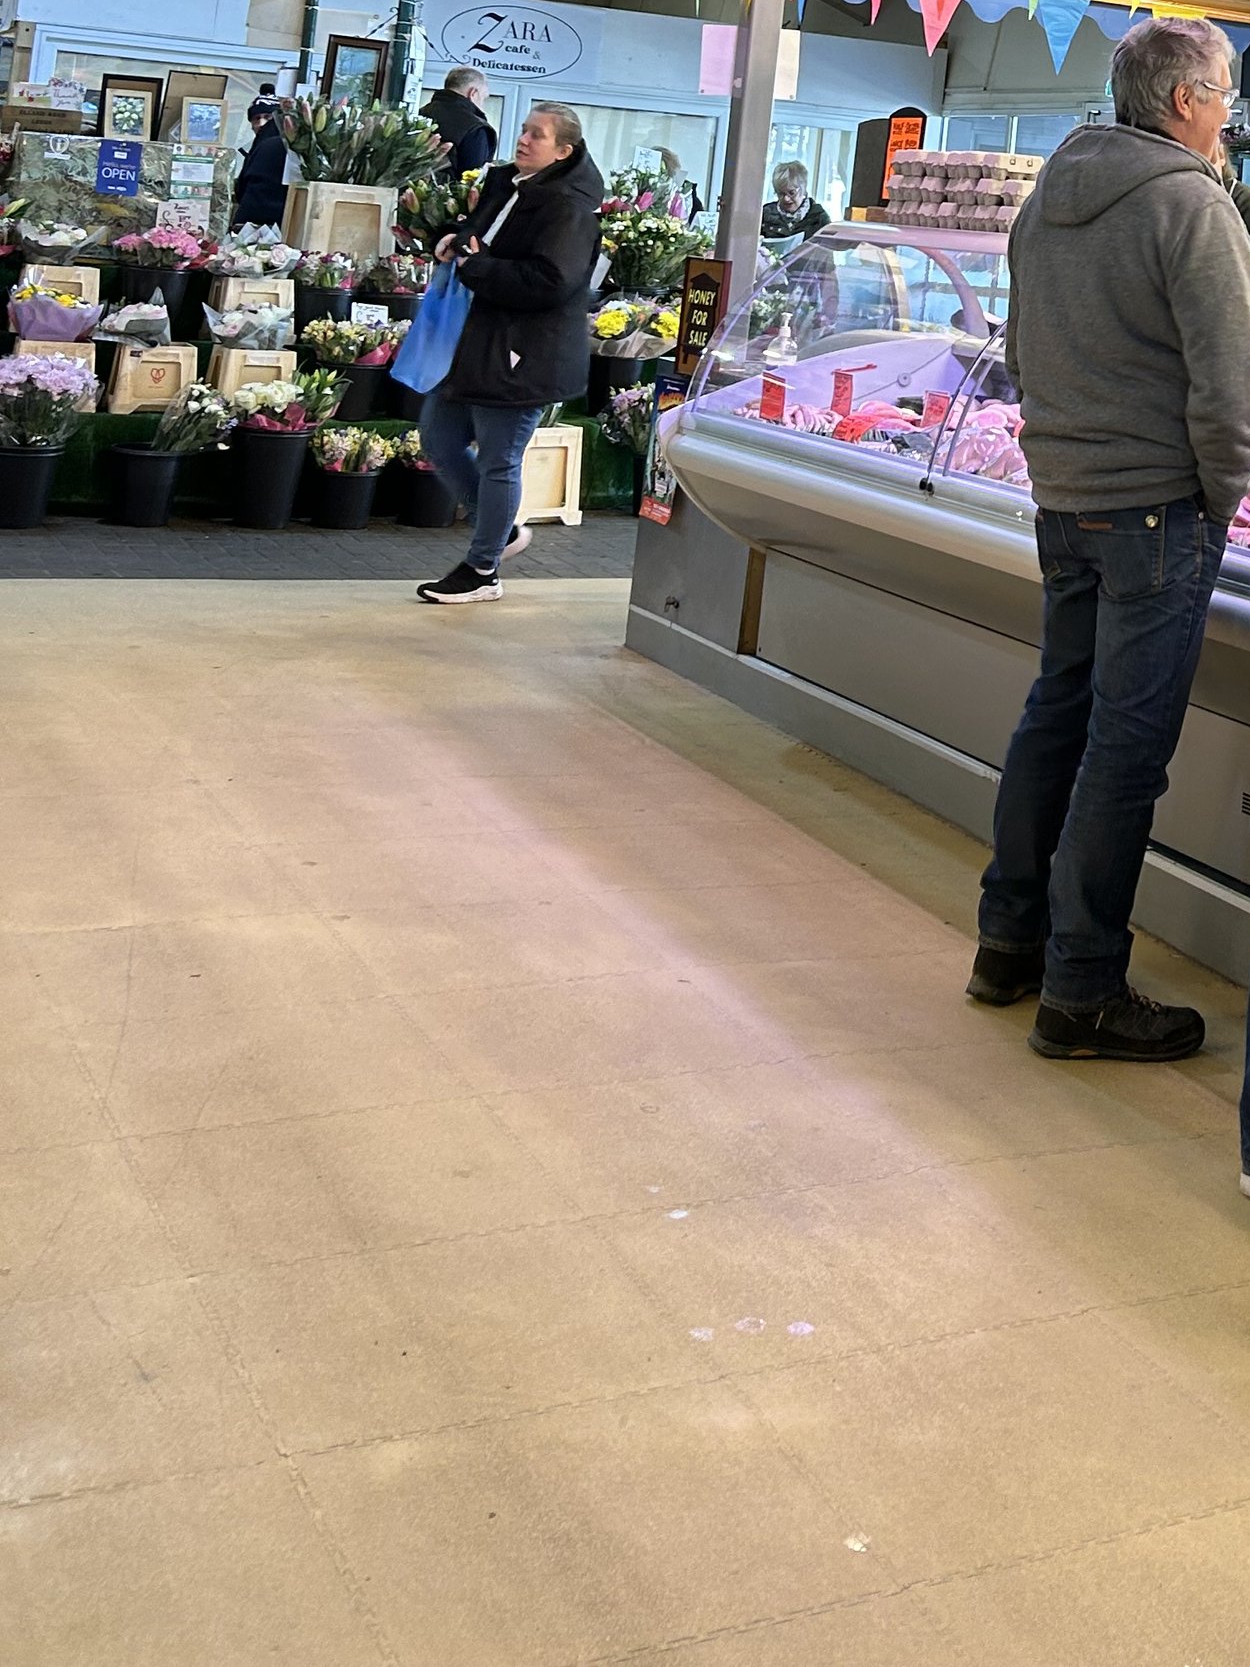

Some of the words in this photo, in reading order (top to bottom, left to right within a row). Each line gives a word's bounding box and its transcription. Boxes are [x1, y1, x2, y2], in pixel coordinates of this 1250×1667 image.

[467, 12, 552, 53] ZARA
[505, 44, 531, 54] cafe
[472, 57, 546, 74] Delicatessen
[101, 167, 136, 182] OPEN
[688, 288, 716, 306] HONEY
[691, 310, 708, 327] FOR
[689, 330, 708, 348] SALE
